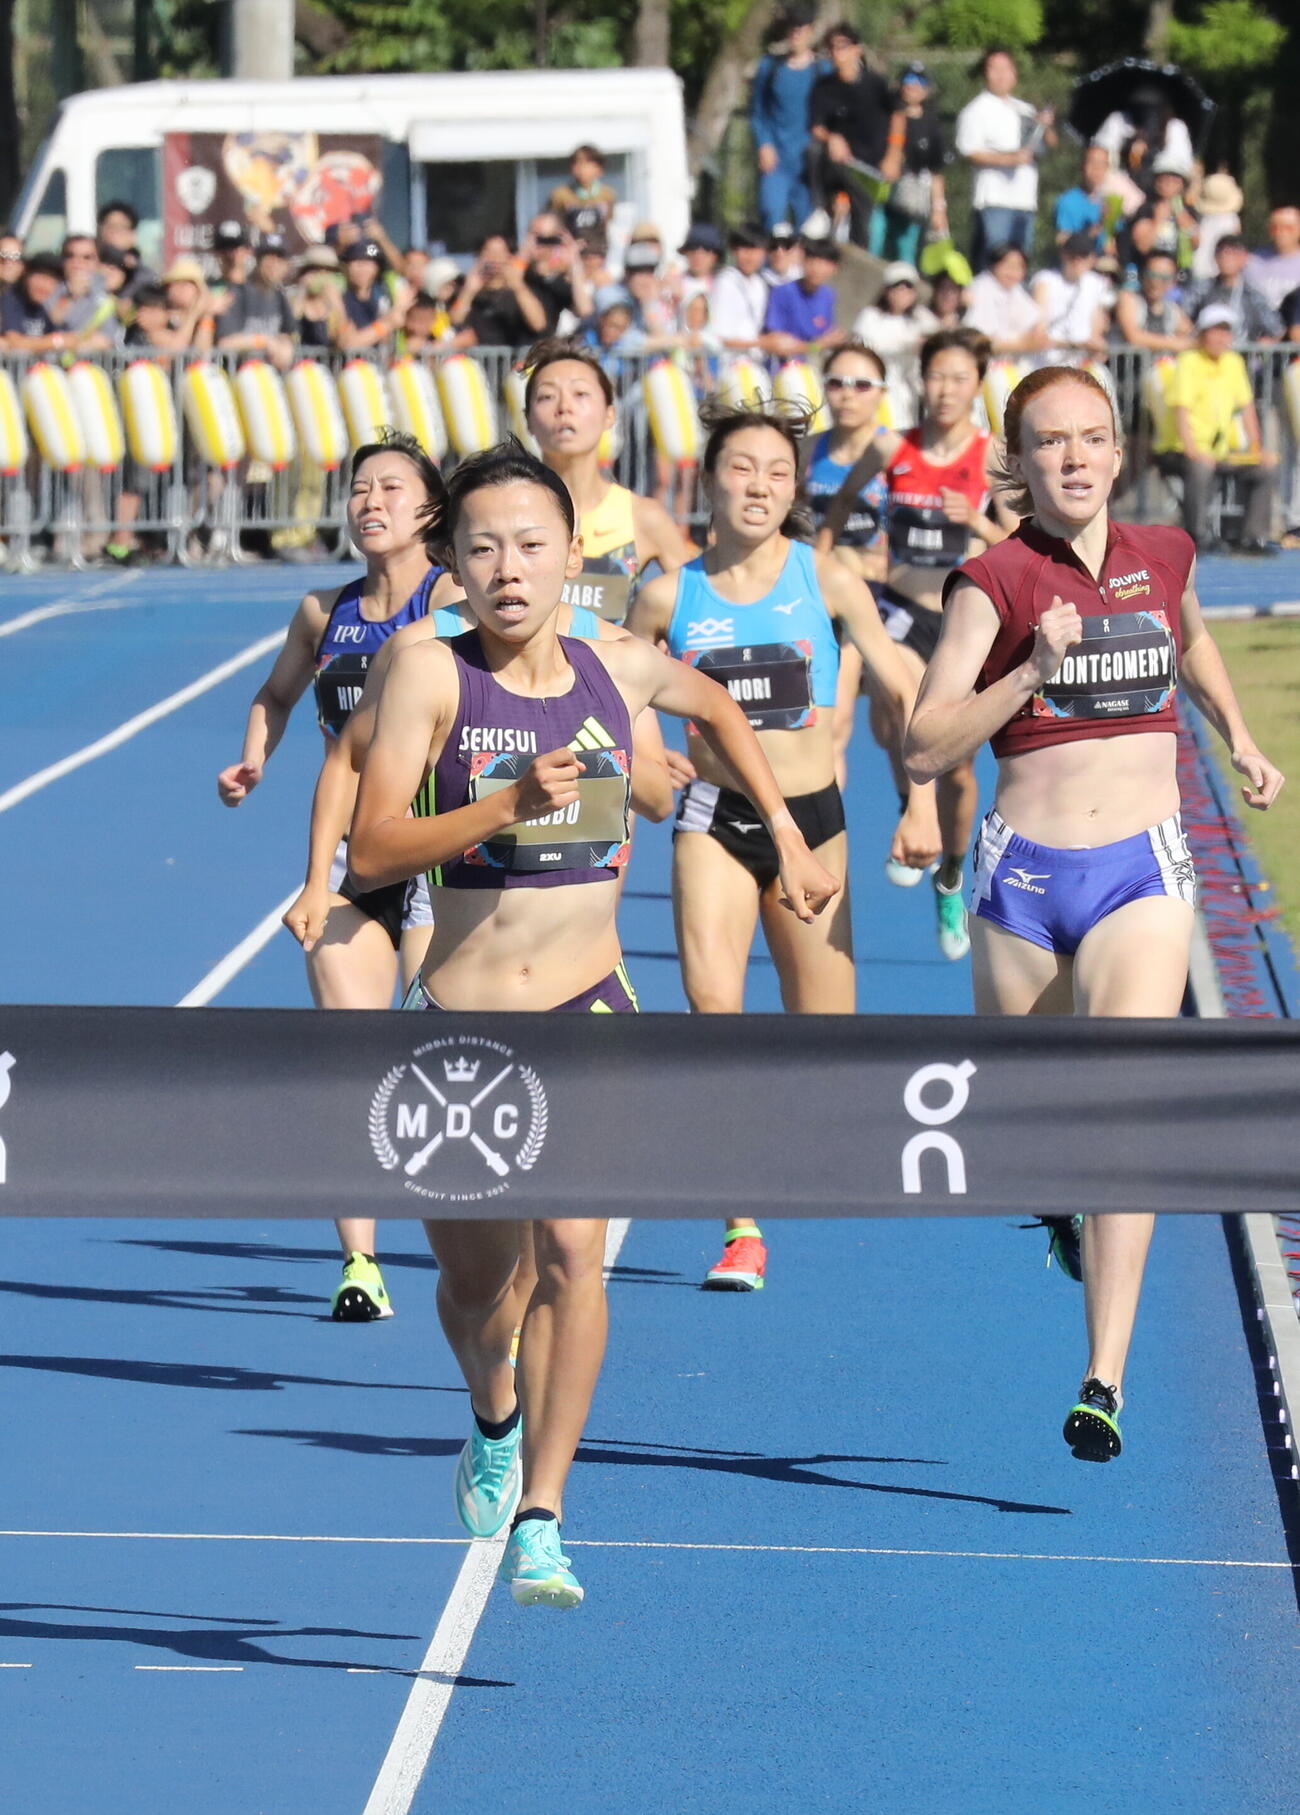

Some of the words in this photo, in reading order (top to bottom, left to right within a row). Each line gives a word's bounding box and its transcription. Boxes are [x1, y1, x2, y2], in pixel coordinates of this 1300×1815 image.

[1109, 570, 1150, 589] SOLVIVE
[333, 625, 367, 643] IPU
[727, 677, 771, 701] MORI
[459, 726, 537, 753] SEKISUI
[539, 852, 562, 862] 2XU
[1002, 877, 1046, 895] MIZUNO
[412, 1036, 454, 1057] MIDDLE
[459, 1034, 514, 1057] DISTANCE
[404, 1180, 447, 1201] CIRCUIT
[449, 1192, 484, 1202] SINCE
